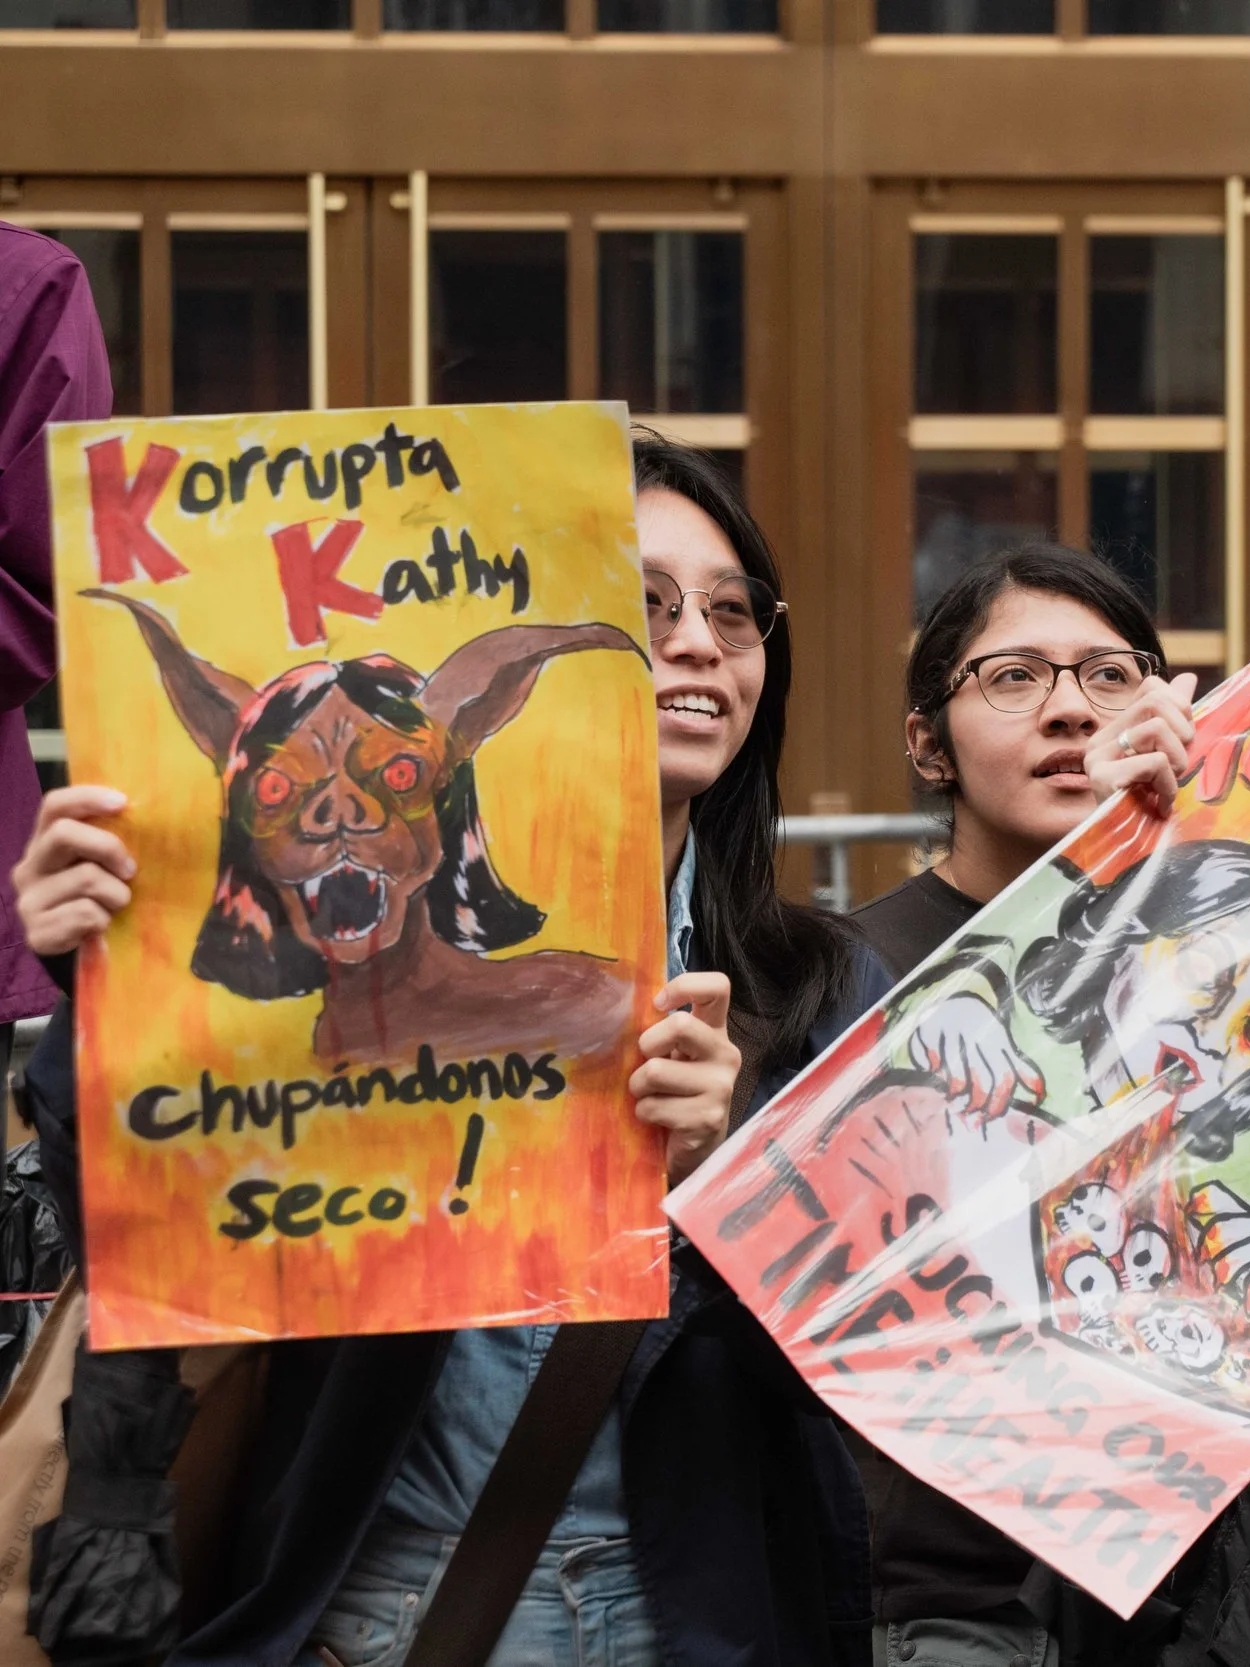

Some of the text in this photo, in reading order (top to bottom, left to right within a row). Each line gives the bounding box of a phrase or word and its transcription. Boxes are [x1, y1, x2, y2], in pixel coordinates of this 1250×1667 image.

[83, 423, 460, 585] Korrupta
[270, 518, 531, 647] Kathy
[881, 1193, 1103, 1436] SUCKING
[897, 1370, 1181, 1590] HEALTH
